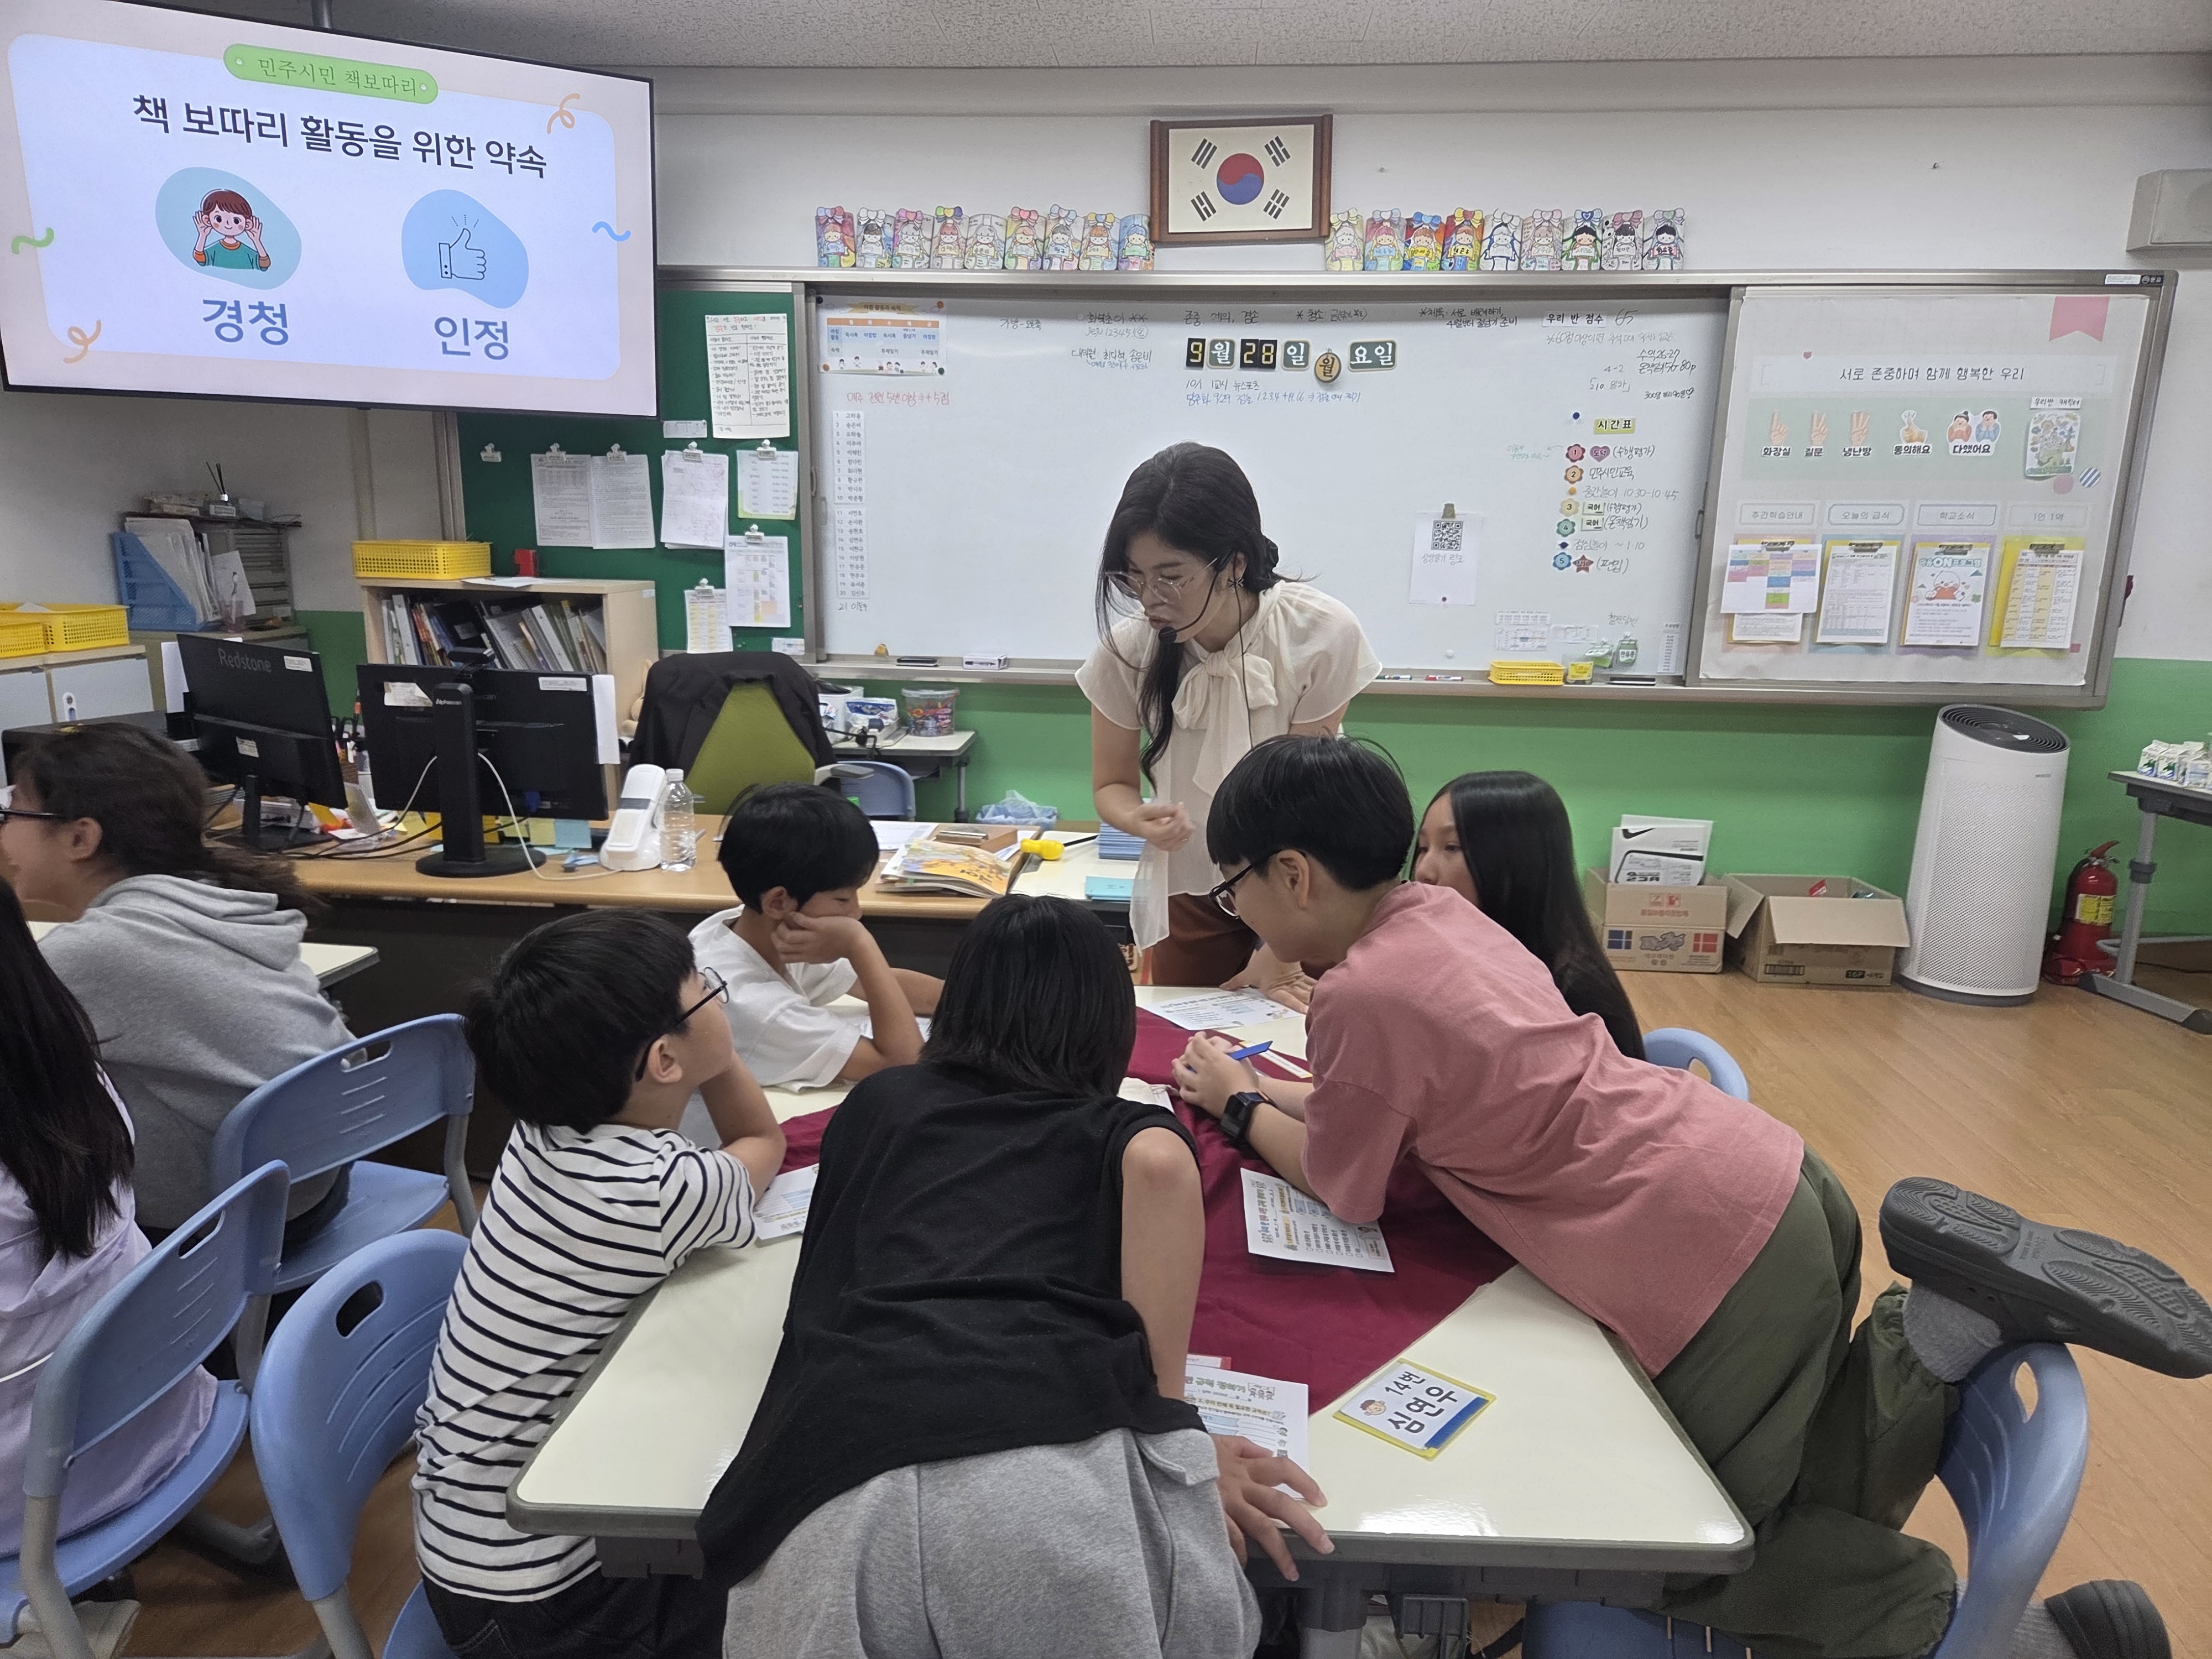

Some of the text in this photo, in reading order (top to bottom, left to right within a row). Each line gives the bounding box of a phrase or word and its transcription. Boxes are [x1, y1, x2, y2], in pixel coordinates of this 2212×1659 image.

[258, 55, 418, 98] 민주시민 책보따리
[133, 94, 547, 179] 책 보따리 활동을 위한 약속
[201, 297, 290, 346] 경청
[1546, 312, 1604, 325] 우리 반 점수
[1615, 308, 1639, 326] 65
[434, 315, 511, 361] 인정
[1189, 342, 1203, 363] 9
[1211, 342, 1230, 364] 월
[1243, 343, 1275, 364] 28
[1286, 342, 1306, 366] 일
[1350, 341, 1394, 366] 요일
[1319, 356, 1334, 378] 월
[1840, 367, 2025, 381] 서로 존중하며 함께 행복한 우리
[1598, 420, 1632, 430] 시간표
[1762, 448, 1791, 457] 화장실
[1804, 448, 1823, 457] 질문
[1843, 448, 1872, 457] 냉난방
[1893, 446, 1931, 456] 동의해요
[1952, 445, 1991, 455] 다했어요
[1751, 511, 1803, 520] 주간학습안내
[1841, 511, 1891, 520] 오늘의 급식
[1939, 512, 1975, 520] 학교소식
[218, 648, 272, 673] Redstone
[1385, 1371, 1426, 1396] 14번
[1386, 1386, 1458, 1434] 심연우
